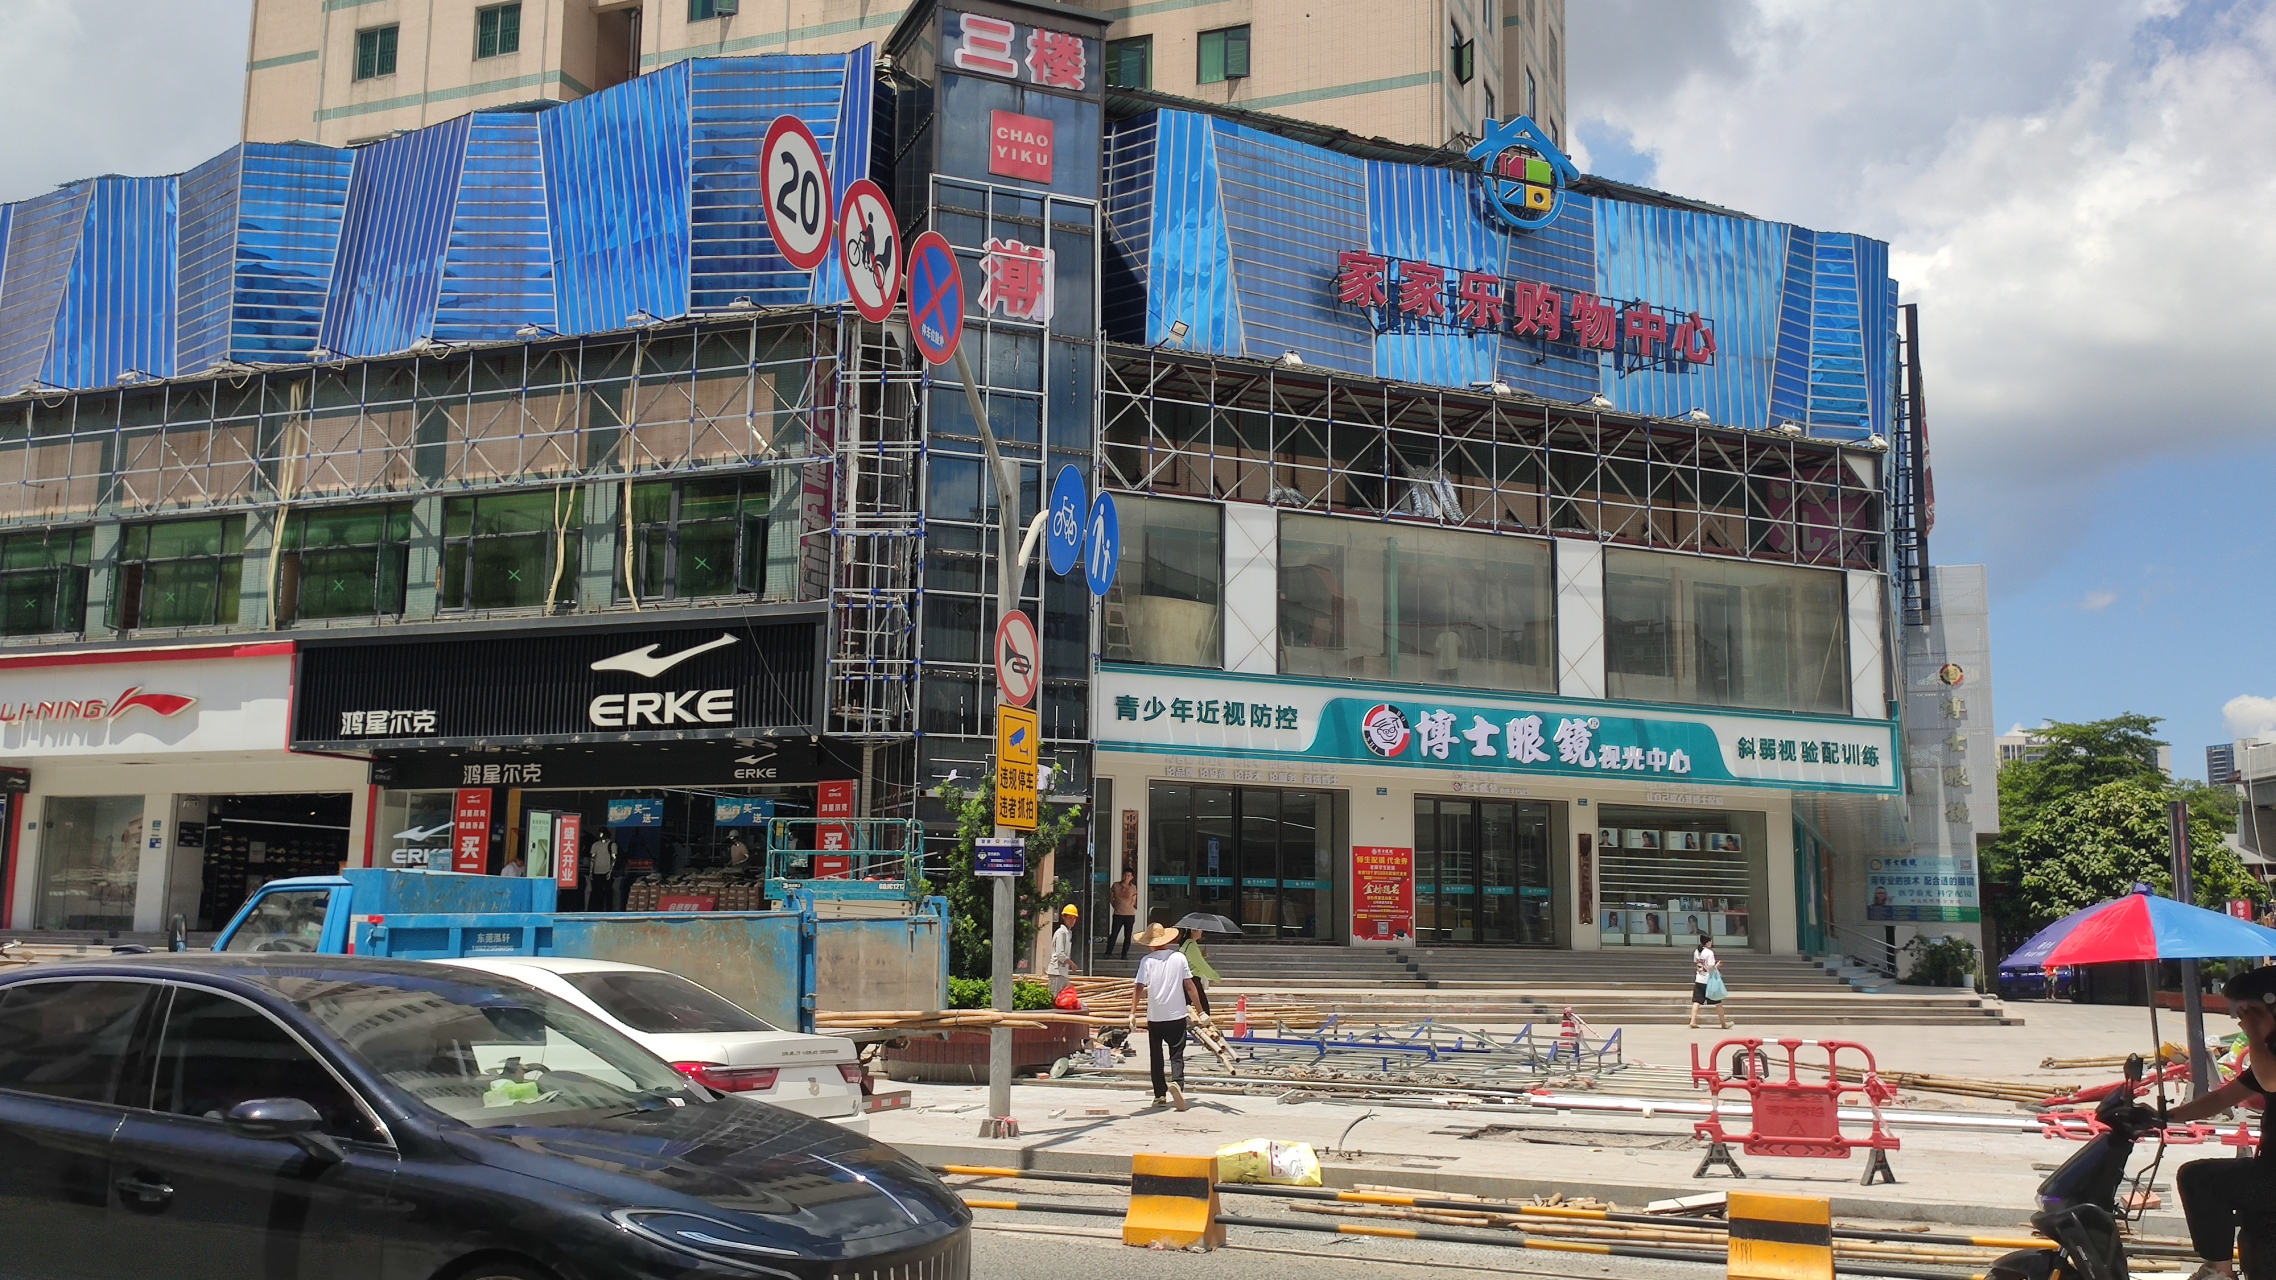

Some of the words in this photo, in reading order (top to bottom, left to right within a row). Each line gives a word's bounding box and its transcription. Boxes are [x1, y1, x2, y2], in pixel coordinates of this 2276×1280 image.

[957, 14, 1084, 90] 三楼
[996, 127, 1049, 147] CHAO
[996, 145, 1048, 166] YIKU
[777, 151, 820, 236] 20
[1338, 249, 1717, 365] 家家乐购物中心
[0, 699, 107, 723] LI-NING
[589, 689, 734, 727] ERKE
[1115, 694, 1298, 730] 青少年近视防控
[340, 709, 438, 735] 鸿星尔克
[1599, 745, 1691, 774] 视光中心
[463, 763, 542, 785] 鸿星尔克
[734, 768, 777, 779] ERKE
[999, 766, 1034, 792] 违规停车
[634, 804, 651, 814] 买一
[642, 814, 660, 824] 送一
[743, 804, 761, 814] 买一
[752, 813, 771, 824] 送一
[999, 795, 1034, 820] 违者抓拍
[391, 848, 453, 864] ERK
[561, 827, 576, 881] 盛大开业
[1871, 876, 1920, 886] 用专业的技术
[1923, 876, 1975, 887] 配合适的眼镜
